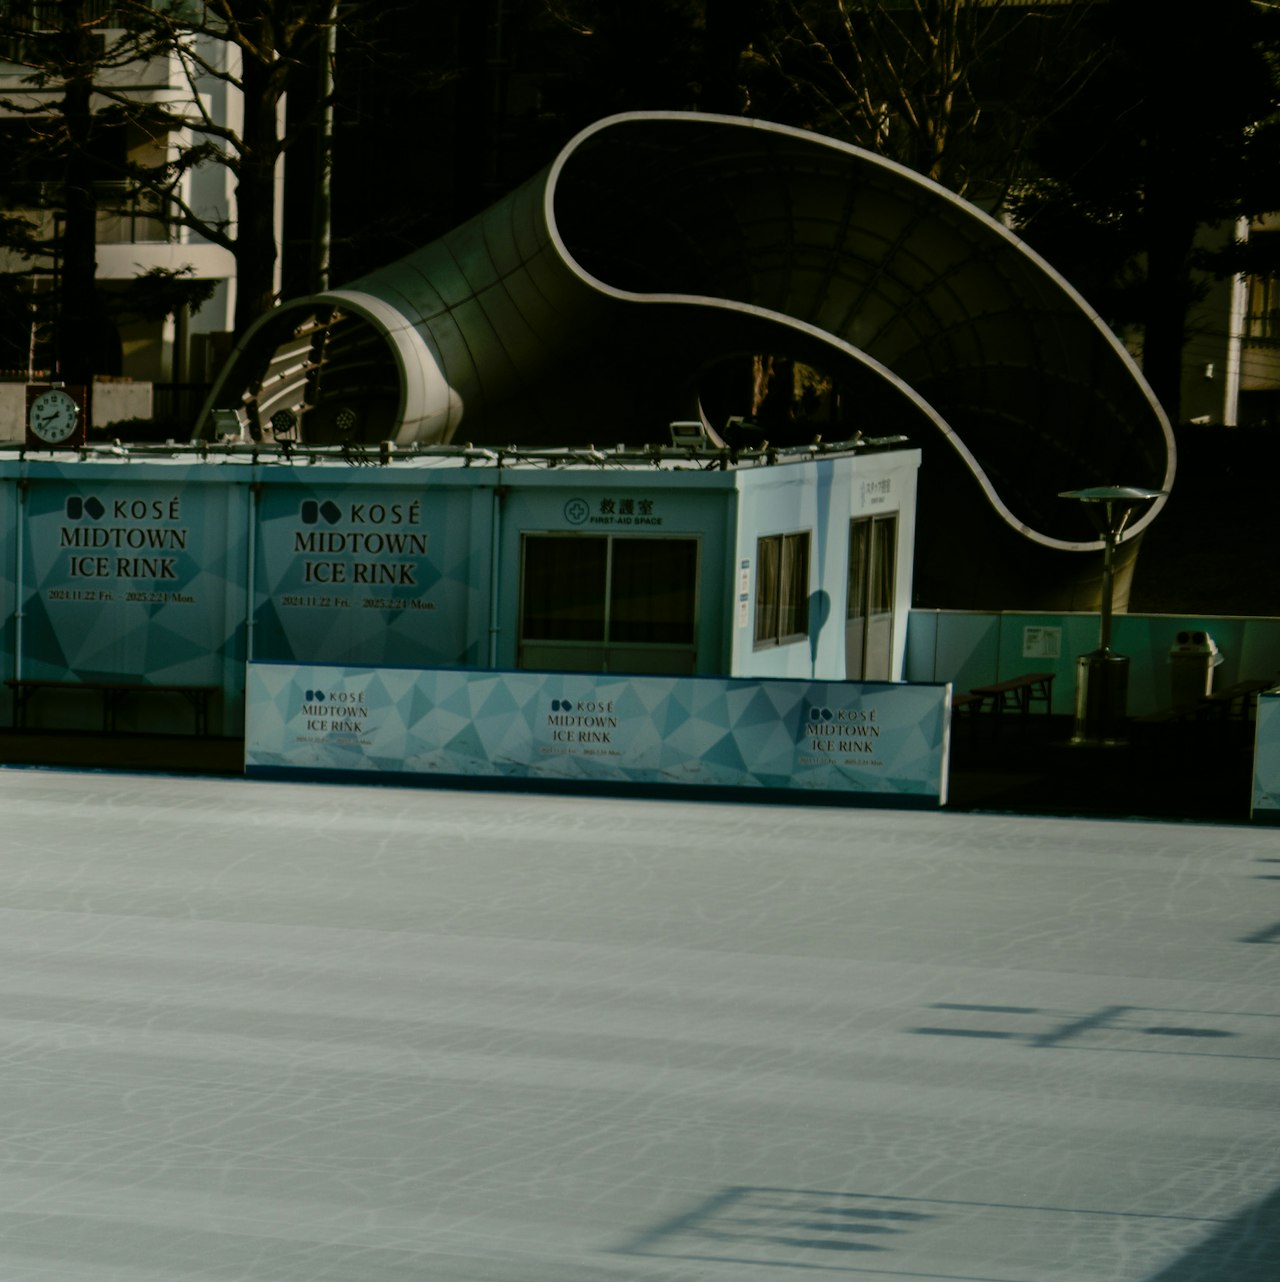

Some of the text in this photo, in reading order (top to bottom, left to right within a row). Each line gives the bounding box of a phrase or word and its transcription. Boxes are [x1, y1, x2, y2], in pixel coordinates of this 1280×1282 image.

[114, 496, 180, 520] KOSÉ
[352, 500, 420, 524] KOSÉ
[600, 498, 654, 515] 救護室
[590, 516, 663, 525] FIRST-AID SPACE
[60, 527, 187, 549] MIDTOWN
[295, 532, 427, 554] MIDTOWN
[71, 557, 176, 578] ICE RINK
[305, 562, 415, 584] ICE RINK
[330, 691, 365, 704] KOSÉ
[302, 705, 368, 718] MIDTOWN
[577, 700, 614, 713] KOSÉ
[548, 715, 617, 728] MIDTOWN
[838, 708, 876, 722] KOSÉ
[307, 719, 362, 733] ICE RINK
[807, 724, 880, 737] MIDTOWN
[553, 730, 611, 743] ICE RINK
[812, 740, 873, 753] ICE RINK
